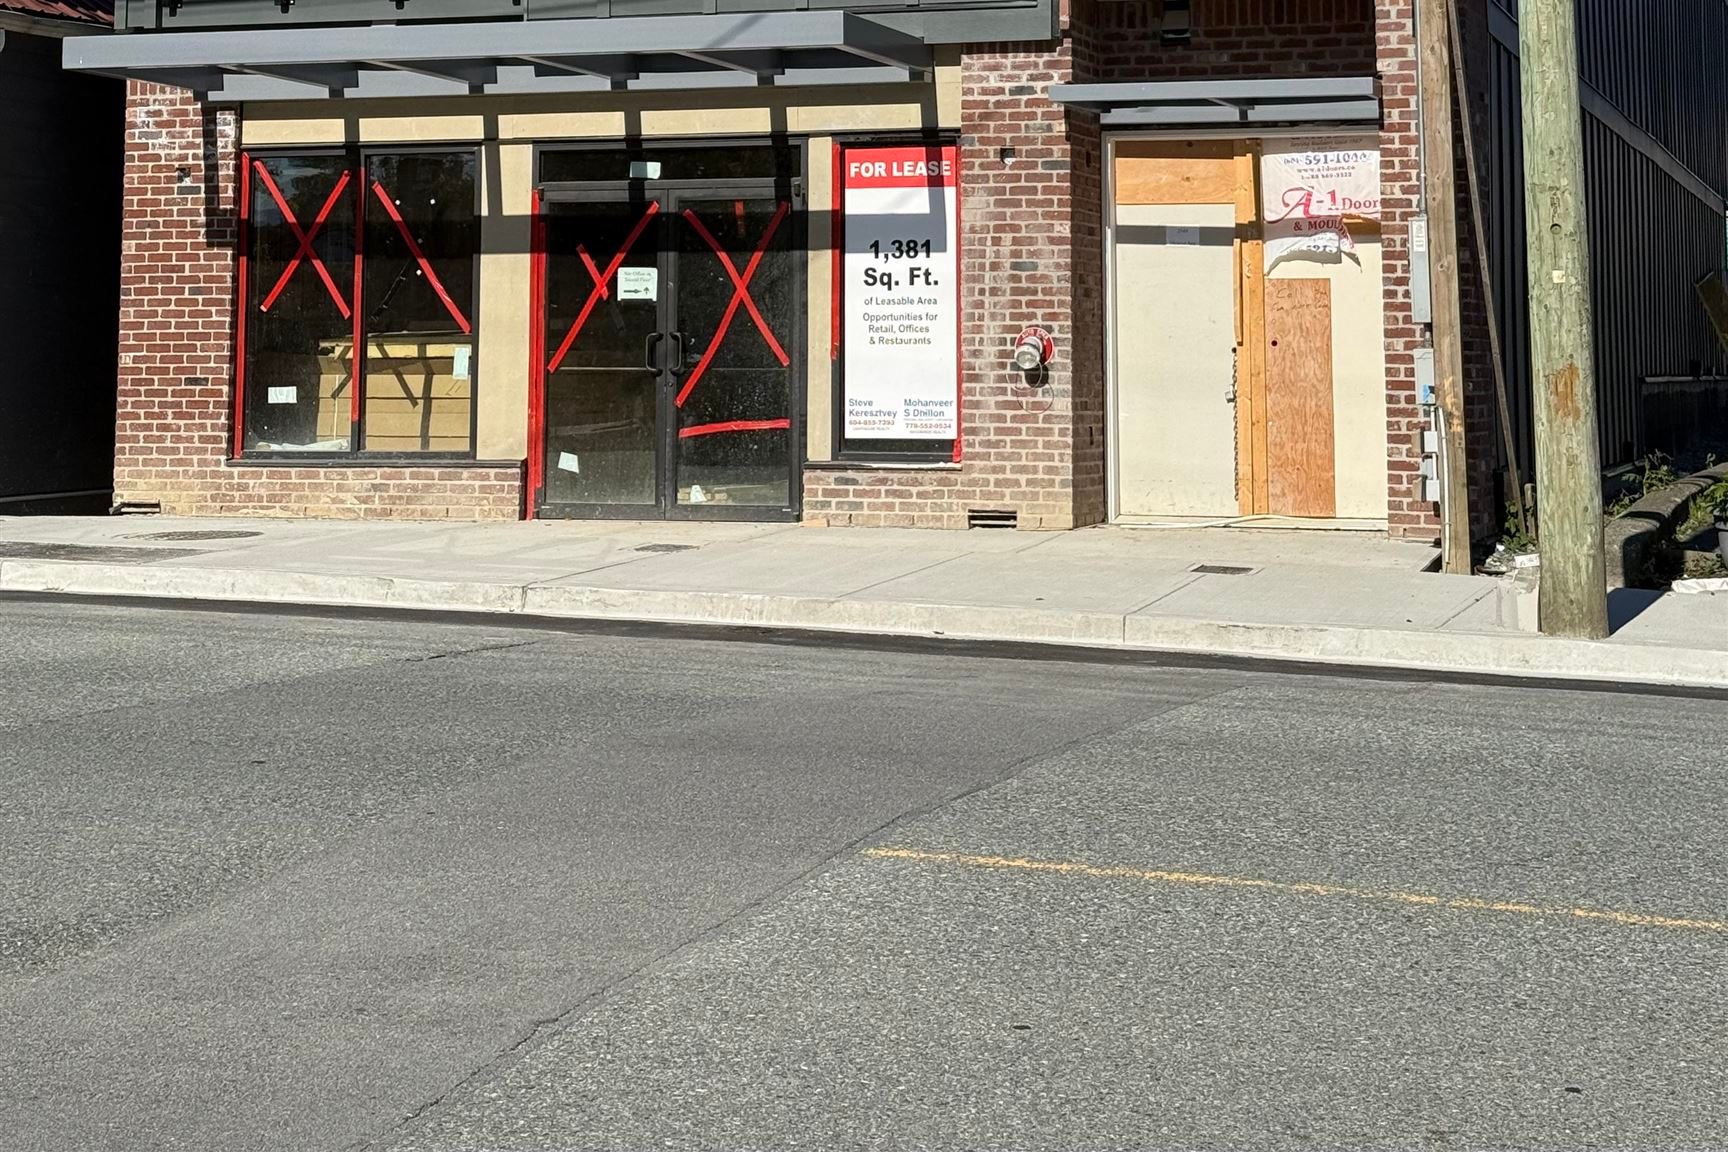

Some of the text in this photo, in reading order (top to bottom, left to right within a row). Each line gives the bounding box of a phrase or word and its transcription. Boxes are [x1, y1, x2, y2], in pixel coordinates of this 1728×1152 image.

[850, 160, 952, 178] FOR LEASE
[1264, 187, 1380, 224] A-1 Door
[1294, 220, 1302, 231] &
[869, 239, 931, 264] 1,381
[863, 267, 938, 291] Sq. Ft.
[864, 296, 937, 305] of Leasable Area
[863, 312, 938, 323] Opportunities for
[868, 324, 930, 334] Retail, Offices
[869, 336, 932, 344] & Restaurants
[849, 398, 873, 407] Steve
[904, 398, 953, 407] Mohanveer
[904, 409, 944, 417] S Dhillon
